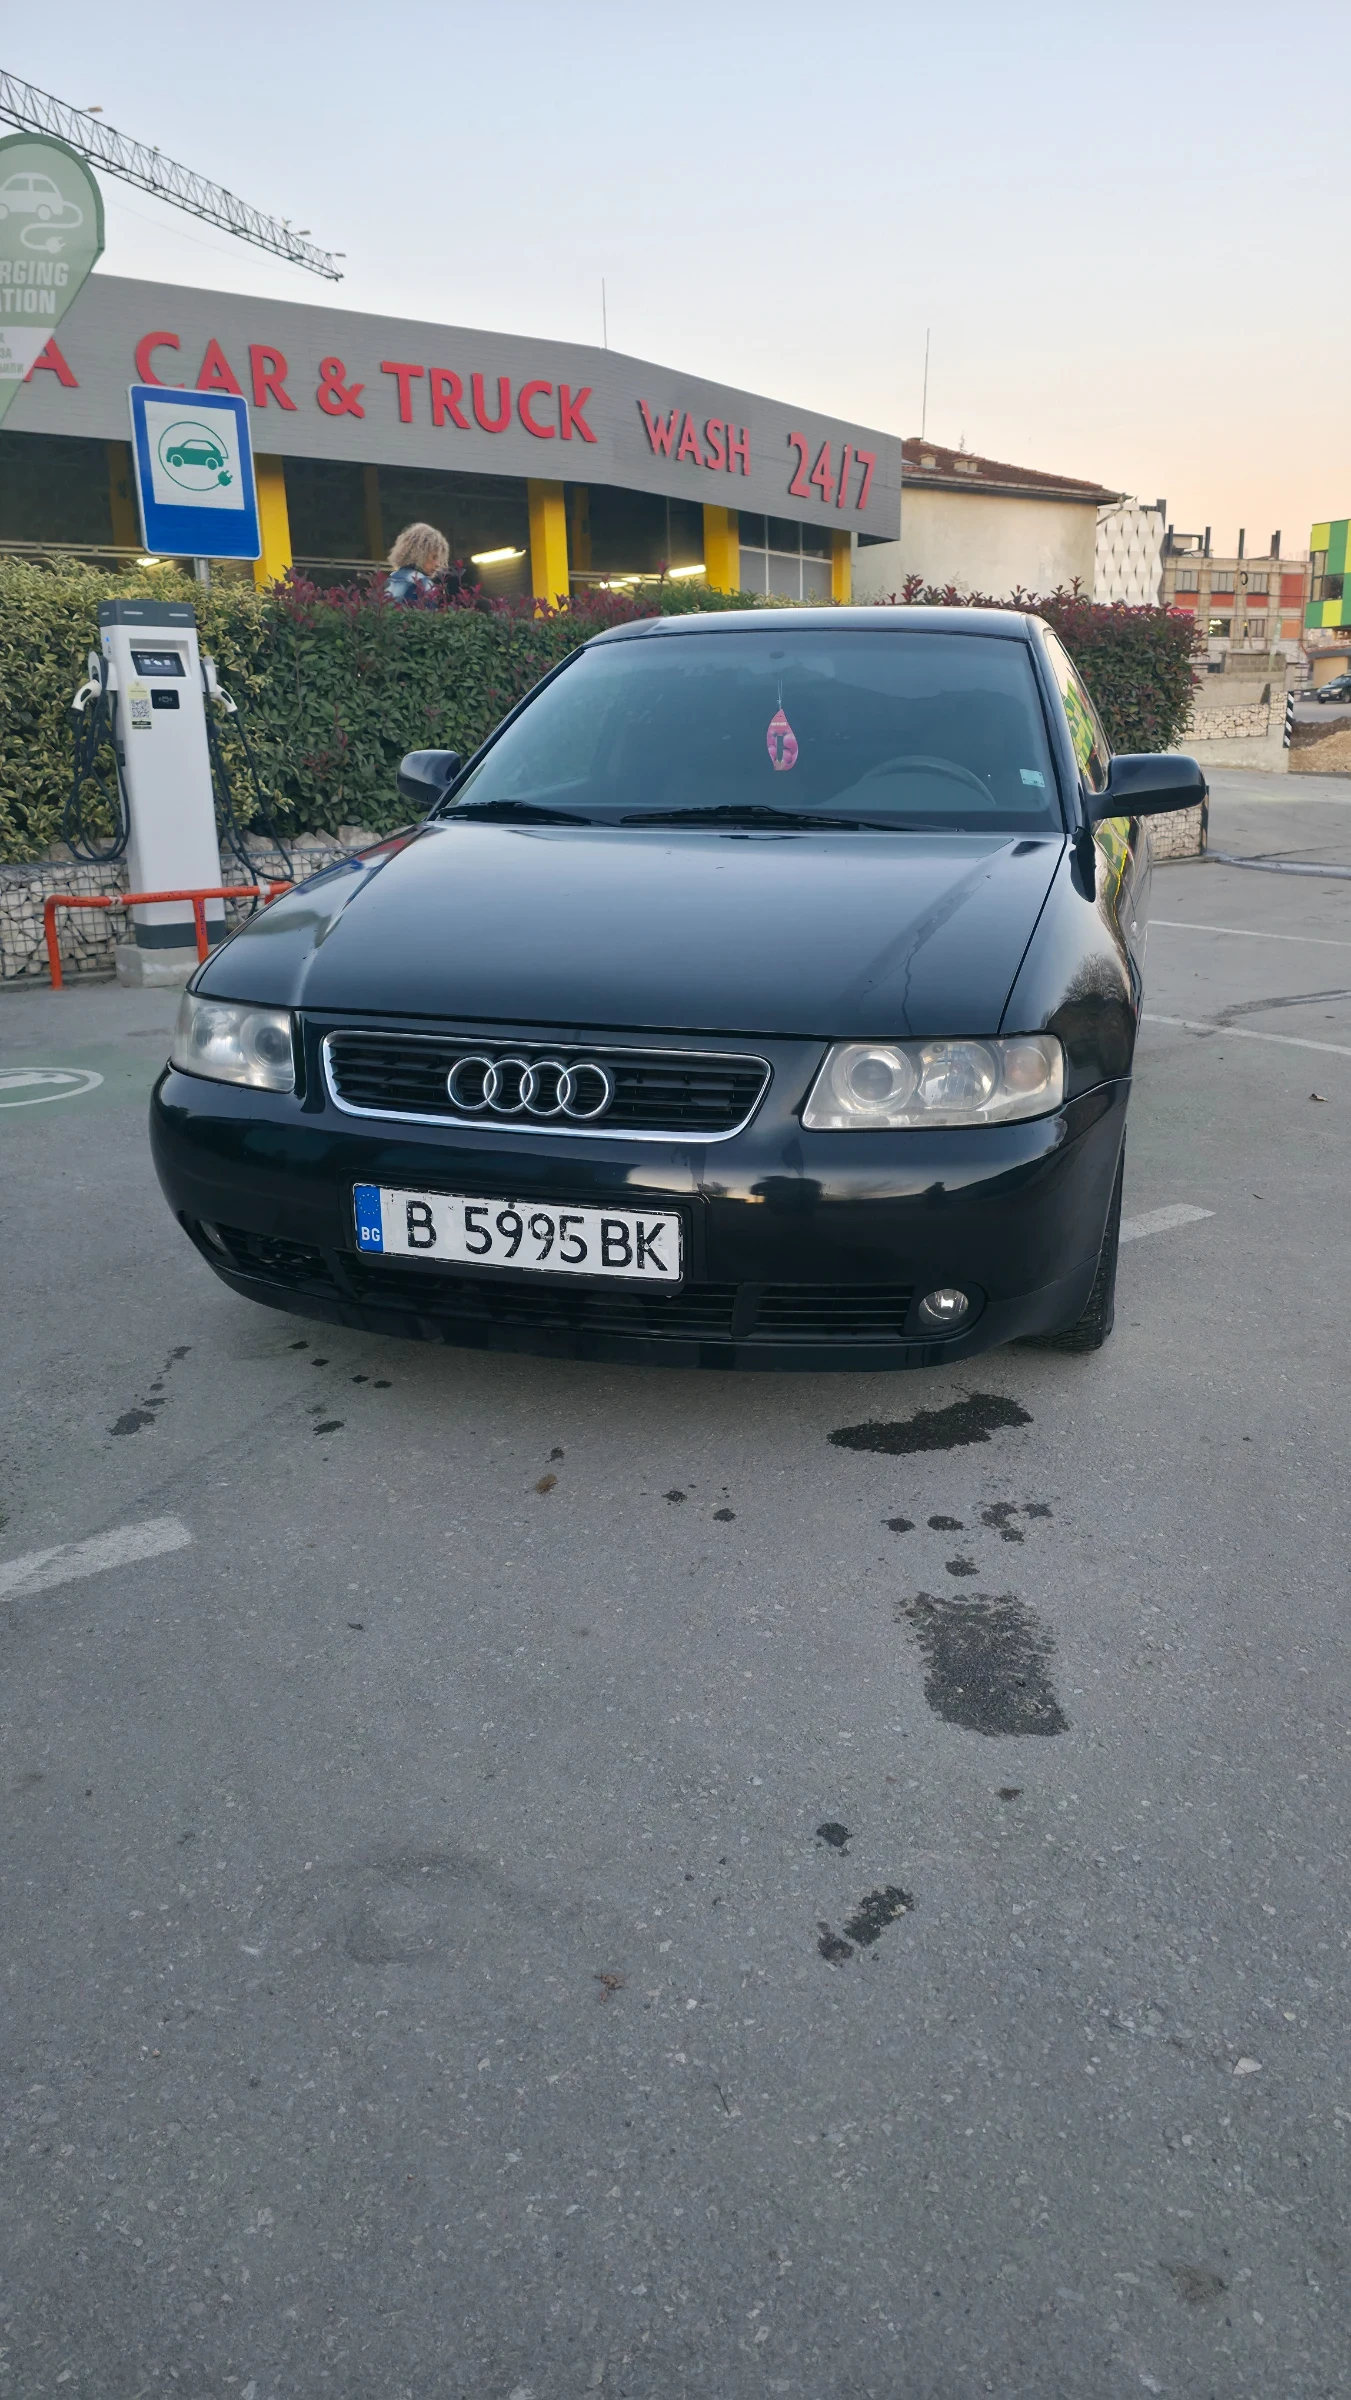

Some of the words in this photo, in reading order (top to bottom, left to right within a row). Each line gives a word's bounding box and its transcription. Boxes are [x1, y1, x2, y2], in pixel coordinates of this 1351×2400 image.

[0, 288, 56, 314] TION
[135, 331, 298, 411] CAR
[317, 356, 365, 419] &
[381, 360, 598, 443] TRUCK
[639, 397, 751, 477] WASH
[788, 431, 877, 510] 24/7
[361, 1226, 381, 1242] BG
[406, 1200, 437, 1249] B
[465, 1206, 588, 1263] 5995
[600, 1218, 668, 1272] BK
